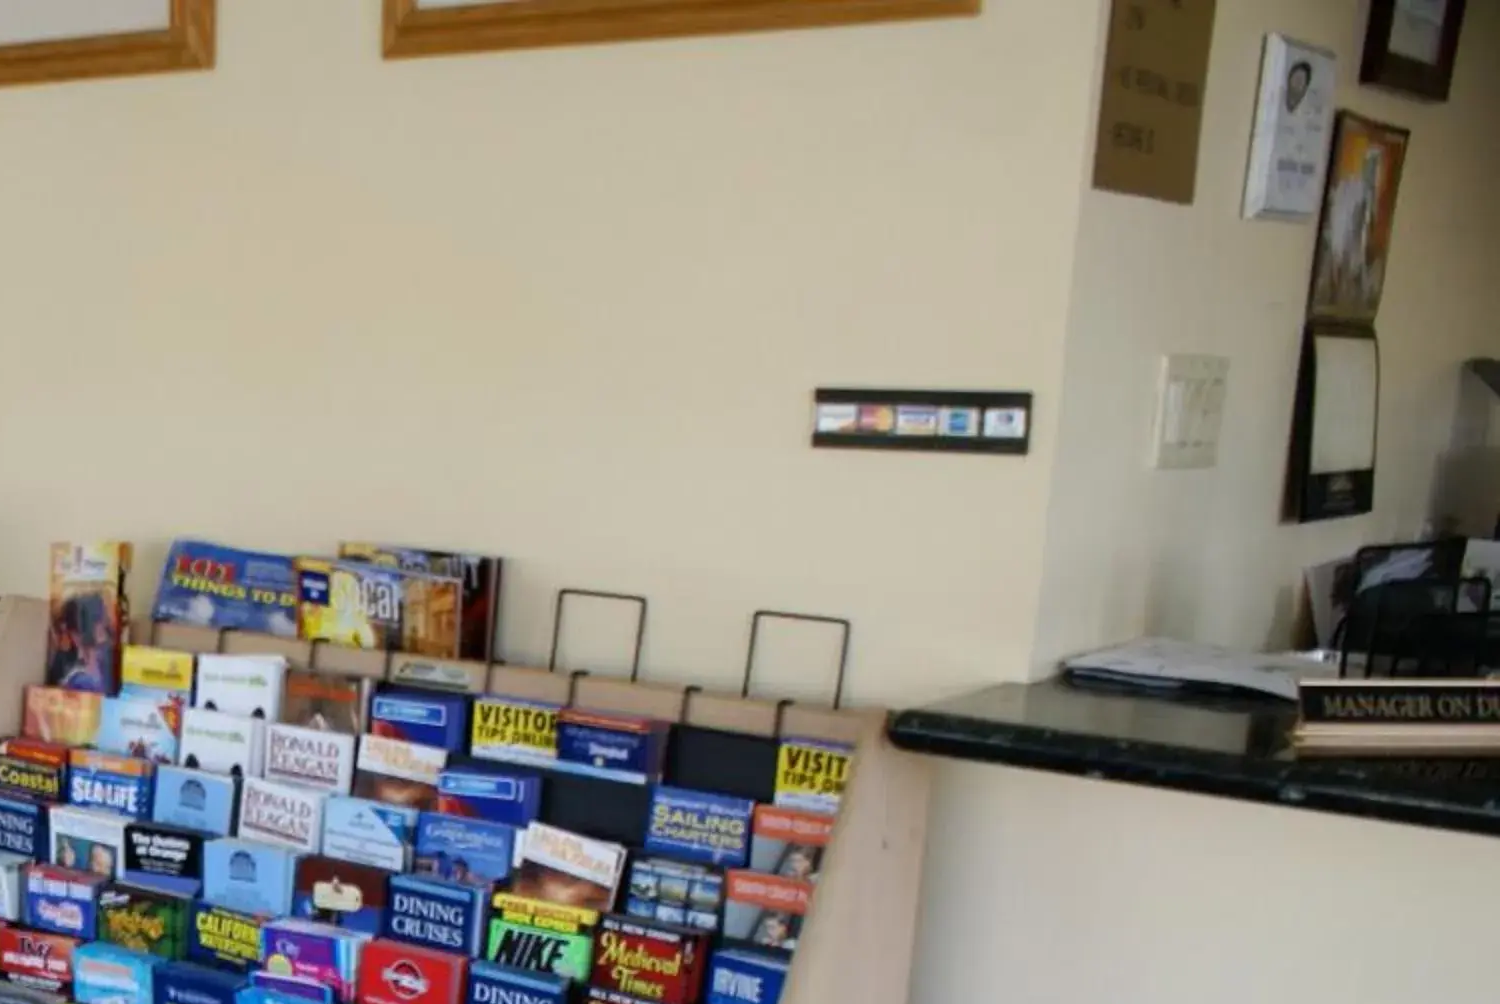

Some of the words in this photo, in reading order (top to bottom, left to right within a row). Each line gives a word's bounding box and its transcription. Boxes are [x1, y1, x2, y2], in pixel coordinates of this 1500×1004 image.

[251, 588, 277, 604] TO
[1323, 694, 1434, 718] MANAGER
[1436, 694, 1471, 719] ON
[270, 727, 339, 758] RONALD
[269, 745, 339, 778] REAGAN
[245, 784, 312, 818] RONALD
[653, 804, 744, 834] SAILING
[393, 895, 465, 924] DINING
[391, 912, 463, 948] CRUISES
[494, 928, 571, 974] NIKE
[598, 931, 682, 977] Medieval
[611, 965, 665, 998] Times
[714, 968, 764, 1004] IRVINE
